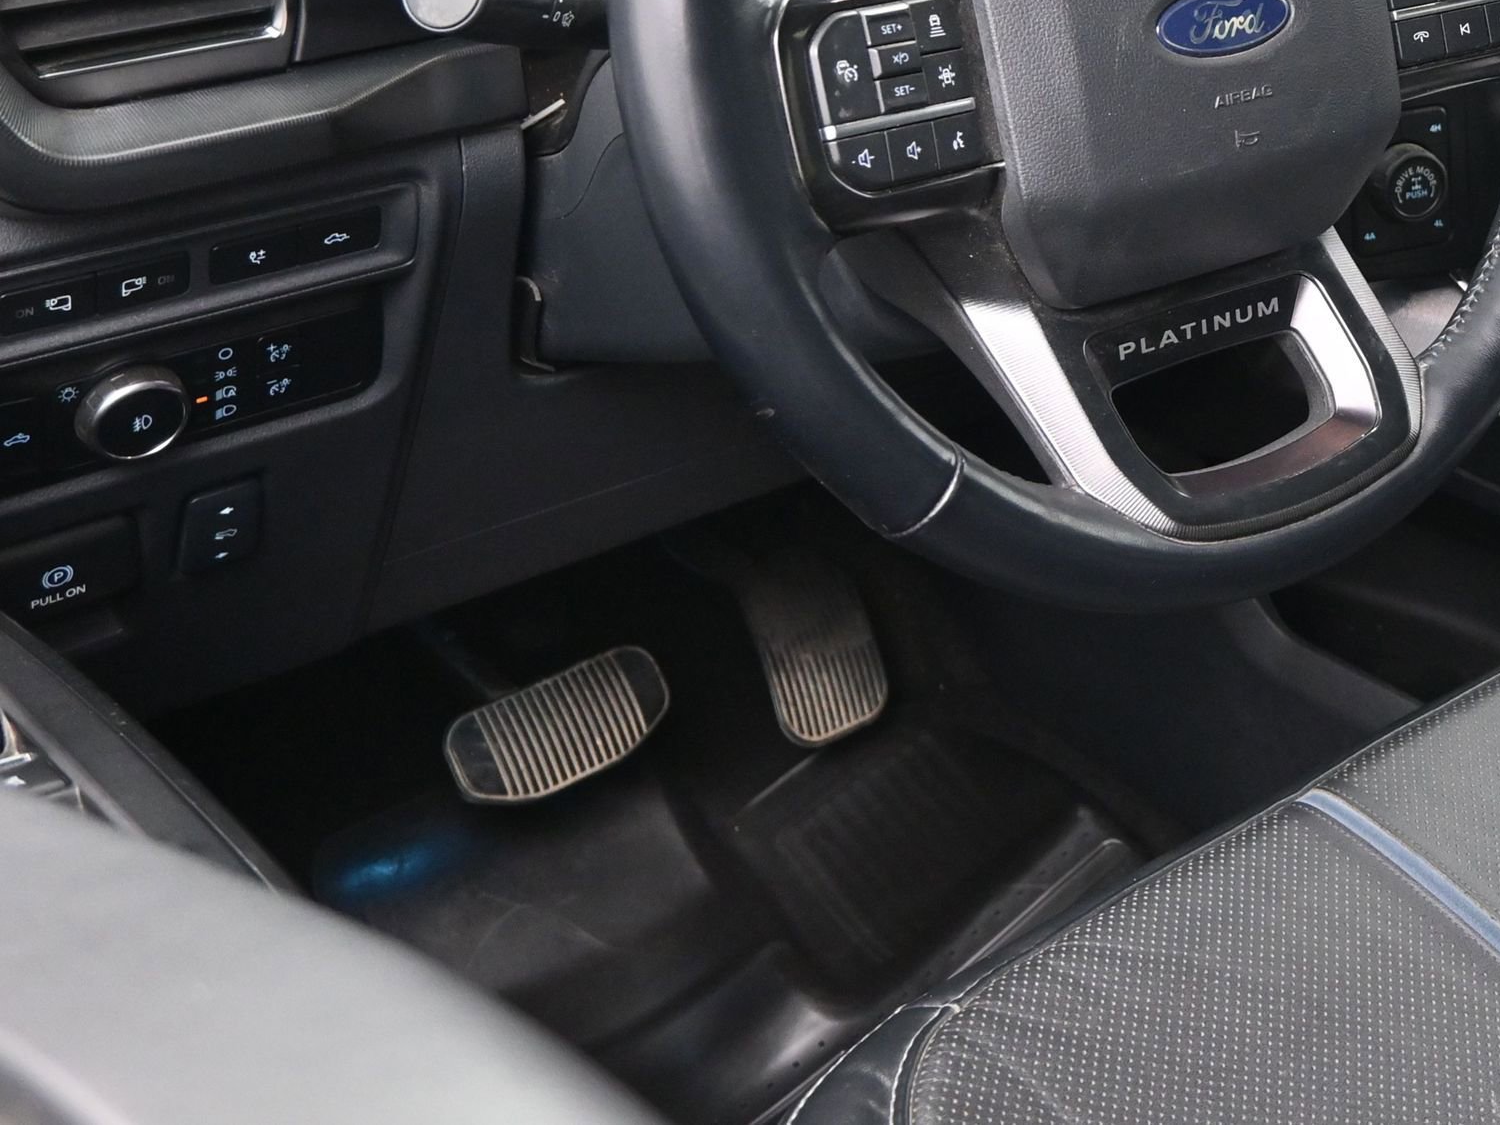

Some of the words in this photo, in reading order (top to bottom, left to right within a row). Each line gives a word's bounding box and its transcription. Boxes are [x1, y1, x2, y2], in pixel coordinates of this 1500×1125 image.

[880, 23, 904, 35] SET+
[1213, 83, 1274, 109] AIRBAG
[1394, 166, 1415, 194] DRIVE
[1415, 165, 1438, 186] MODE
[1405, 189, 1428, 200] PUSH
[15, 306, 35, 320] ON
[1116, 296, 1281, 361] PLATINUM
[30, 592, 65, 610] PULL
[65, 583, 87, 598] ON
